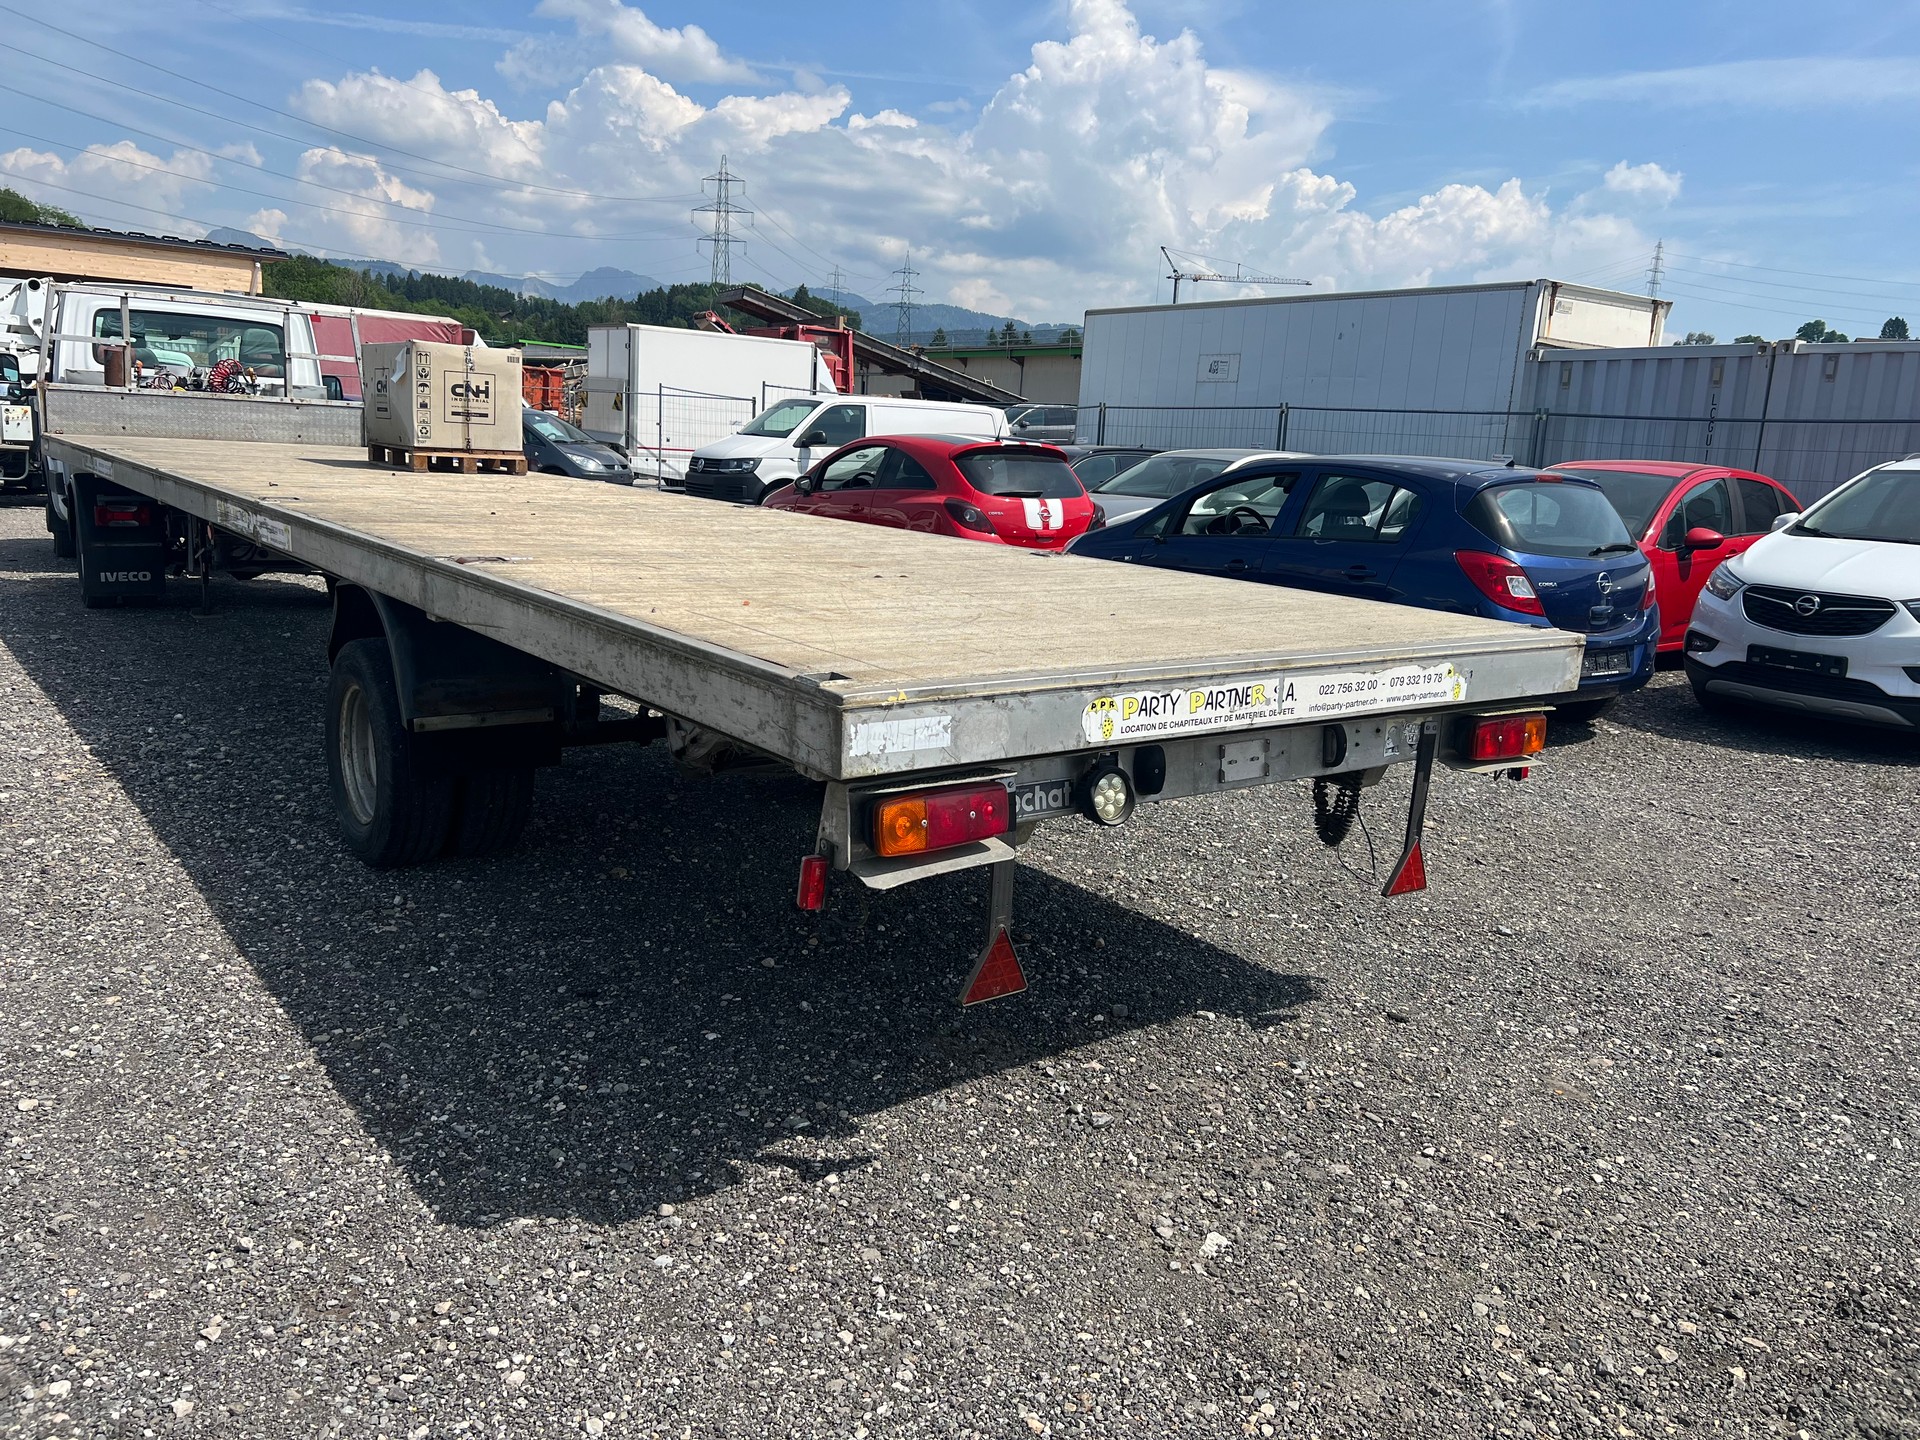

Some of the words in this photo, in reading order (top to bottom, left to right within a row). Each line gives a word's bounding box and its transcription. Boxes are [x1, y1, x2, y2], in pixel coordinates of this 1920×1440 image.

[100, 571, 152, 583] IVECO
[1318, 684, 1335, 696] 022
[1336, 682, 1353, 694] 756
[1355, 680, 1366, 692] 32
[1367, 679, 1378, 691] 00
[1389, 676, 1404, 688] 079
[1406, 674, 1421, 686] 332
[1422, 673, 1432, 684] 19
[1433, 672, 1443, 684] 78
[1122, 693, 1182, 721] PARTY
[1189, 683, 1268, 714] PARTNER
[1308, 697, 1378, 713] info@party-partner.ch
[1386, 690, 1448, 704] www.party-partner.ch
[1120, 719, 1157, 734] LOCATION
[1158, 719, 1168, 730] DE
[1169, 716, 1213, 729] CHAPITEAUX
[1214, 715, 1223, 724] ET
[1224, 714, 1234, 723] DE
[1268, 708, 1278, 717] DE
